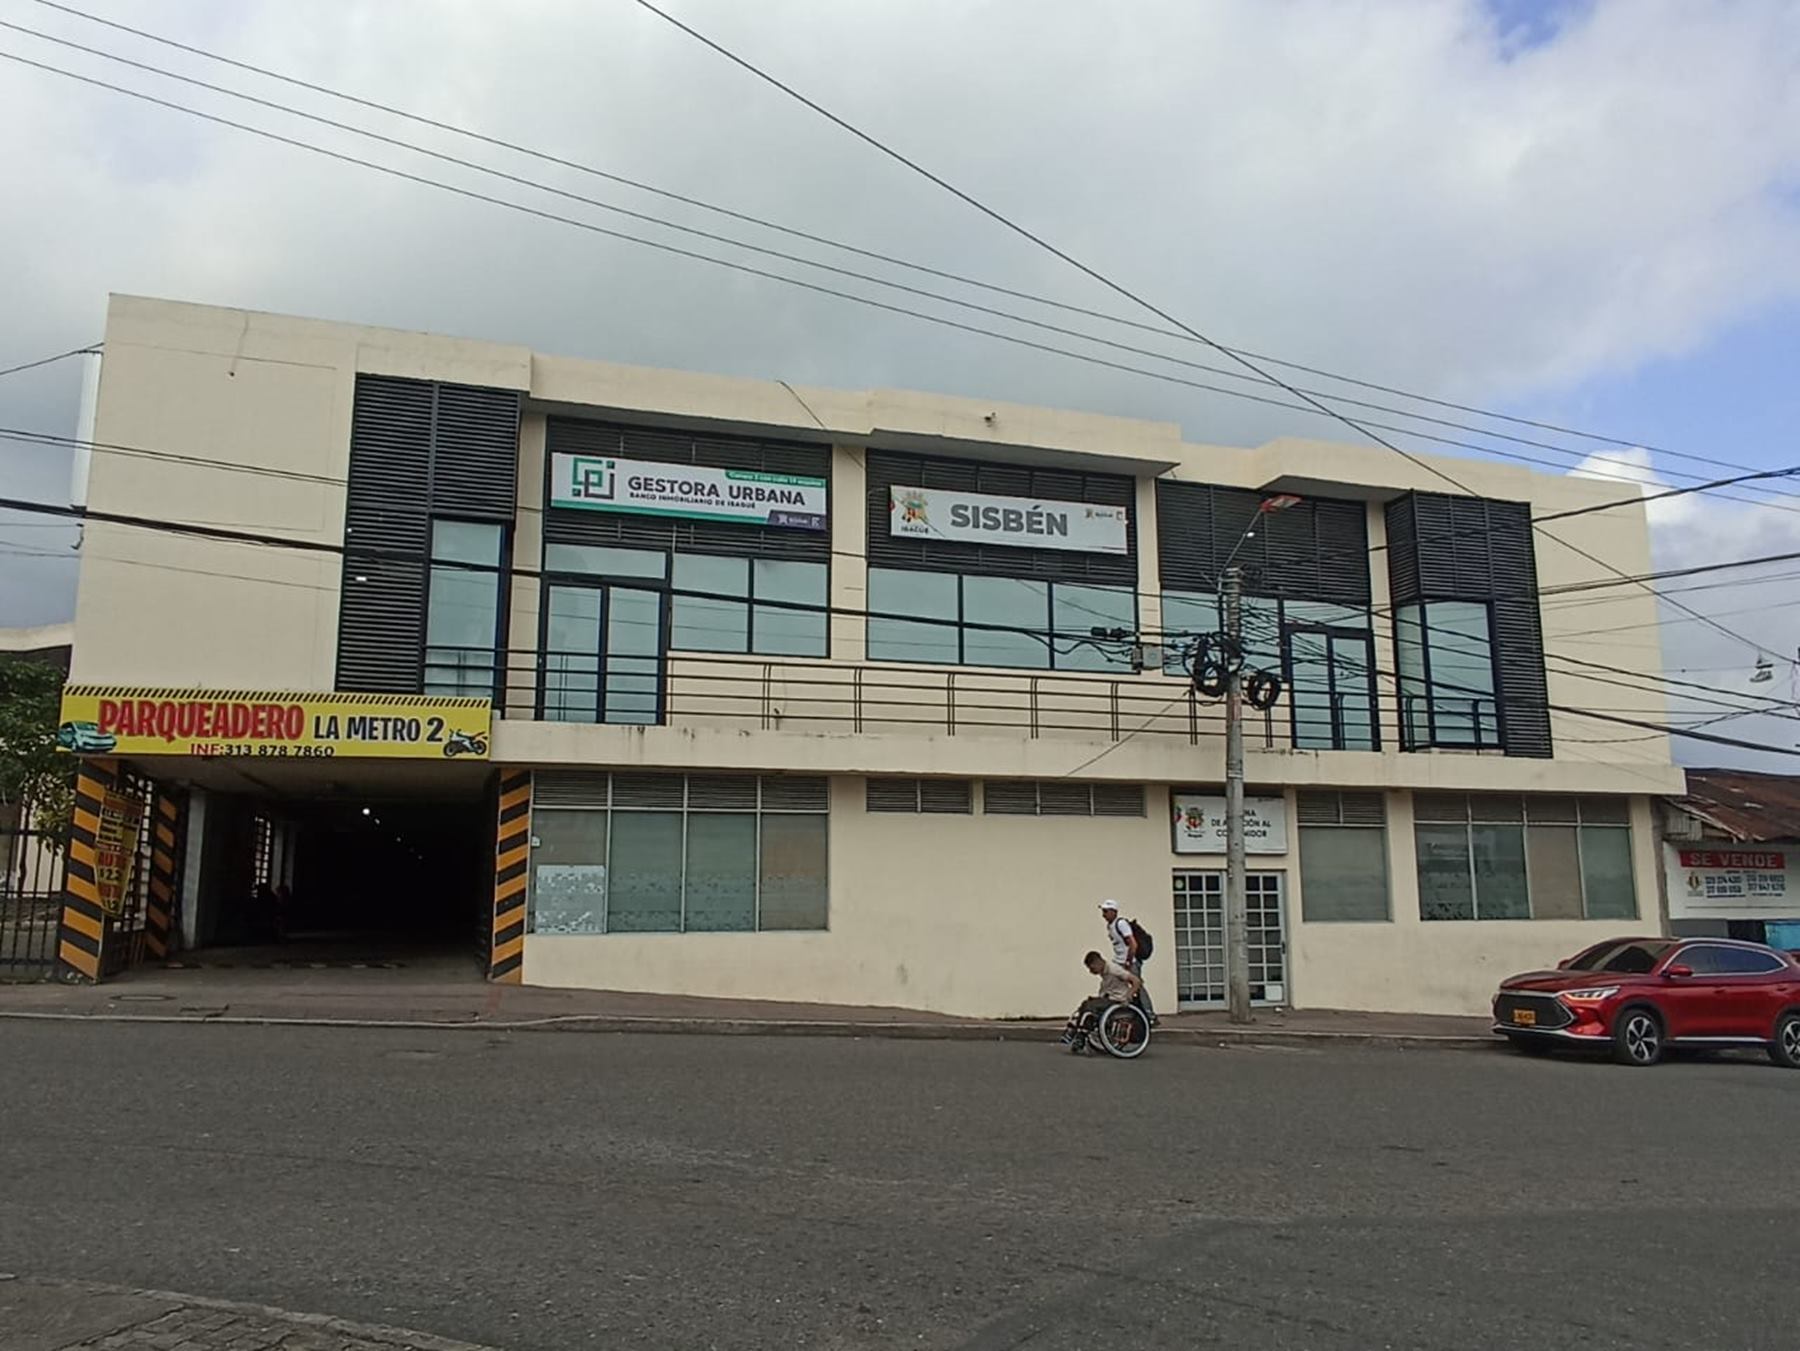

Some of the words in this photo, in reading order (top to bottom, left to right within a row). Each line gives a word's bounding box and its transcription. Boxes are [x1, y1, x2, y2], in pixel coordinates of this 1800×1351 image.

[628, 476, 720, 498] GESTORA
[728, 485, 806, 507] URBANA
[629, 492, 657, 501] BANCO
[659, 496, 713, 506] INMOBILIARIO
[715, 499, 725, 507] DE
[950, 504, 1068, 537] SISBÉN
[97, 699, 305, 745] PARQUEADERO
[314, 715, 341, 741] LA
[346, 716, 421, 742] METRO
[426, 718, 443, 742] 2
[258, 744, 288, 757] 878
[293, 745, 335, 758] 7860
[1211, 818, 1220, 827] DE
[1690, 852, 1713, 866] SE
[1719, 853, 1777, 868] VENDE
